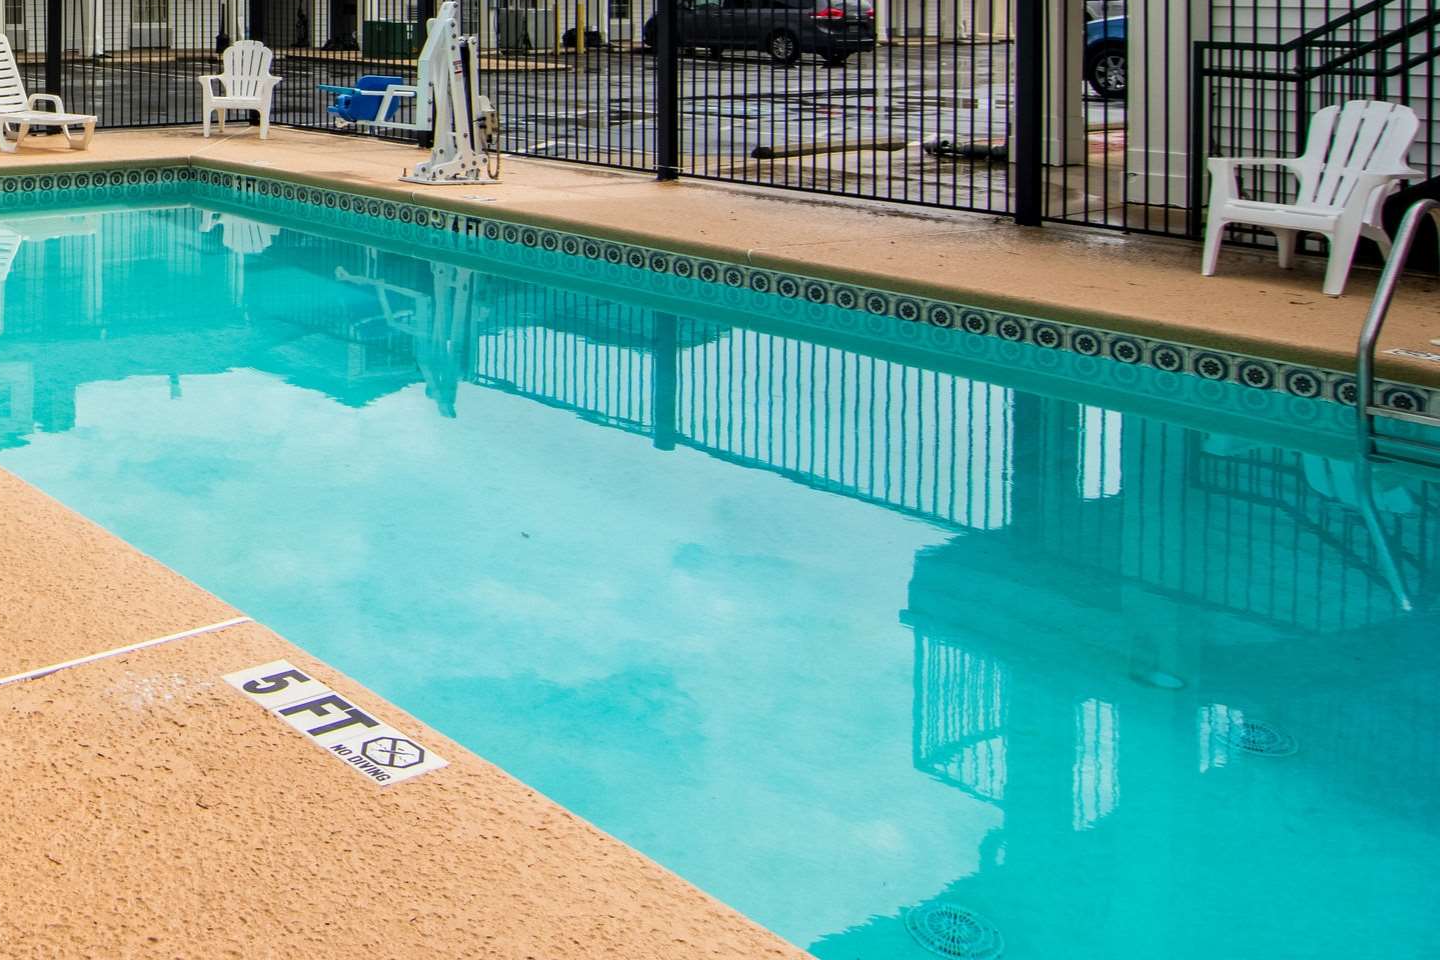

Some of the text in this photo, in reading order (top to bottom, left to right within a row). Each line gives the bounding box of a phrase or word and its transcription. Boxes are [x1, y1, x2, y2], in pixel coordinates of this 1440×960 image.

[246, 176, 257, 192] FT
[451, 215, 481, 237] 4 FT
[242, 669, 381, 737] 5 FT
[329, 743, 391, 783] NO DIVING
